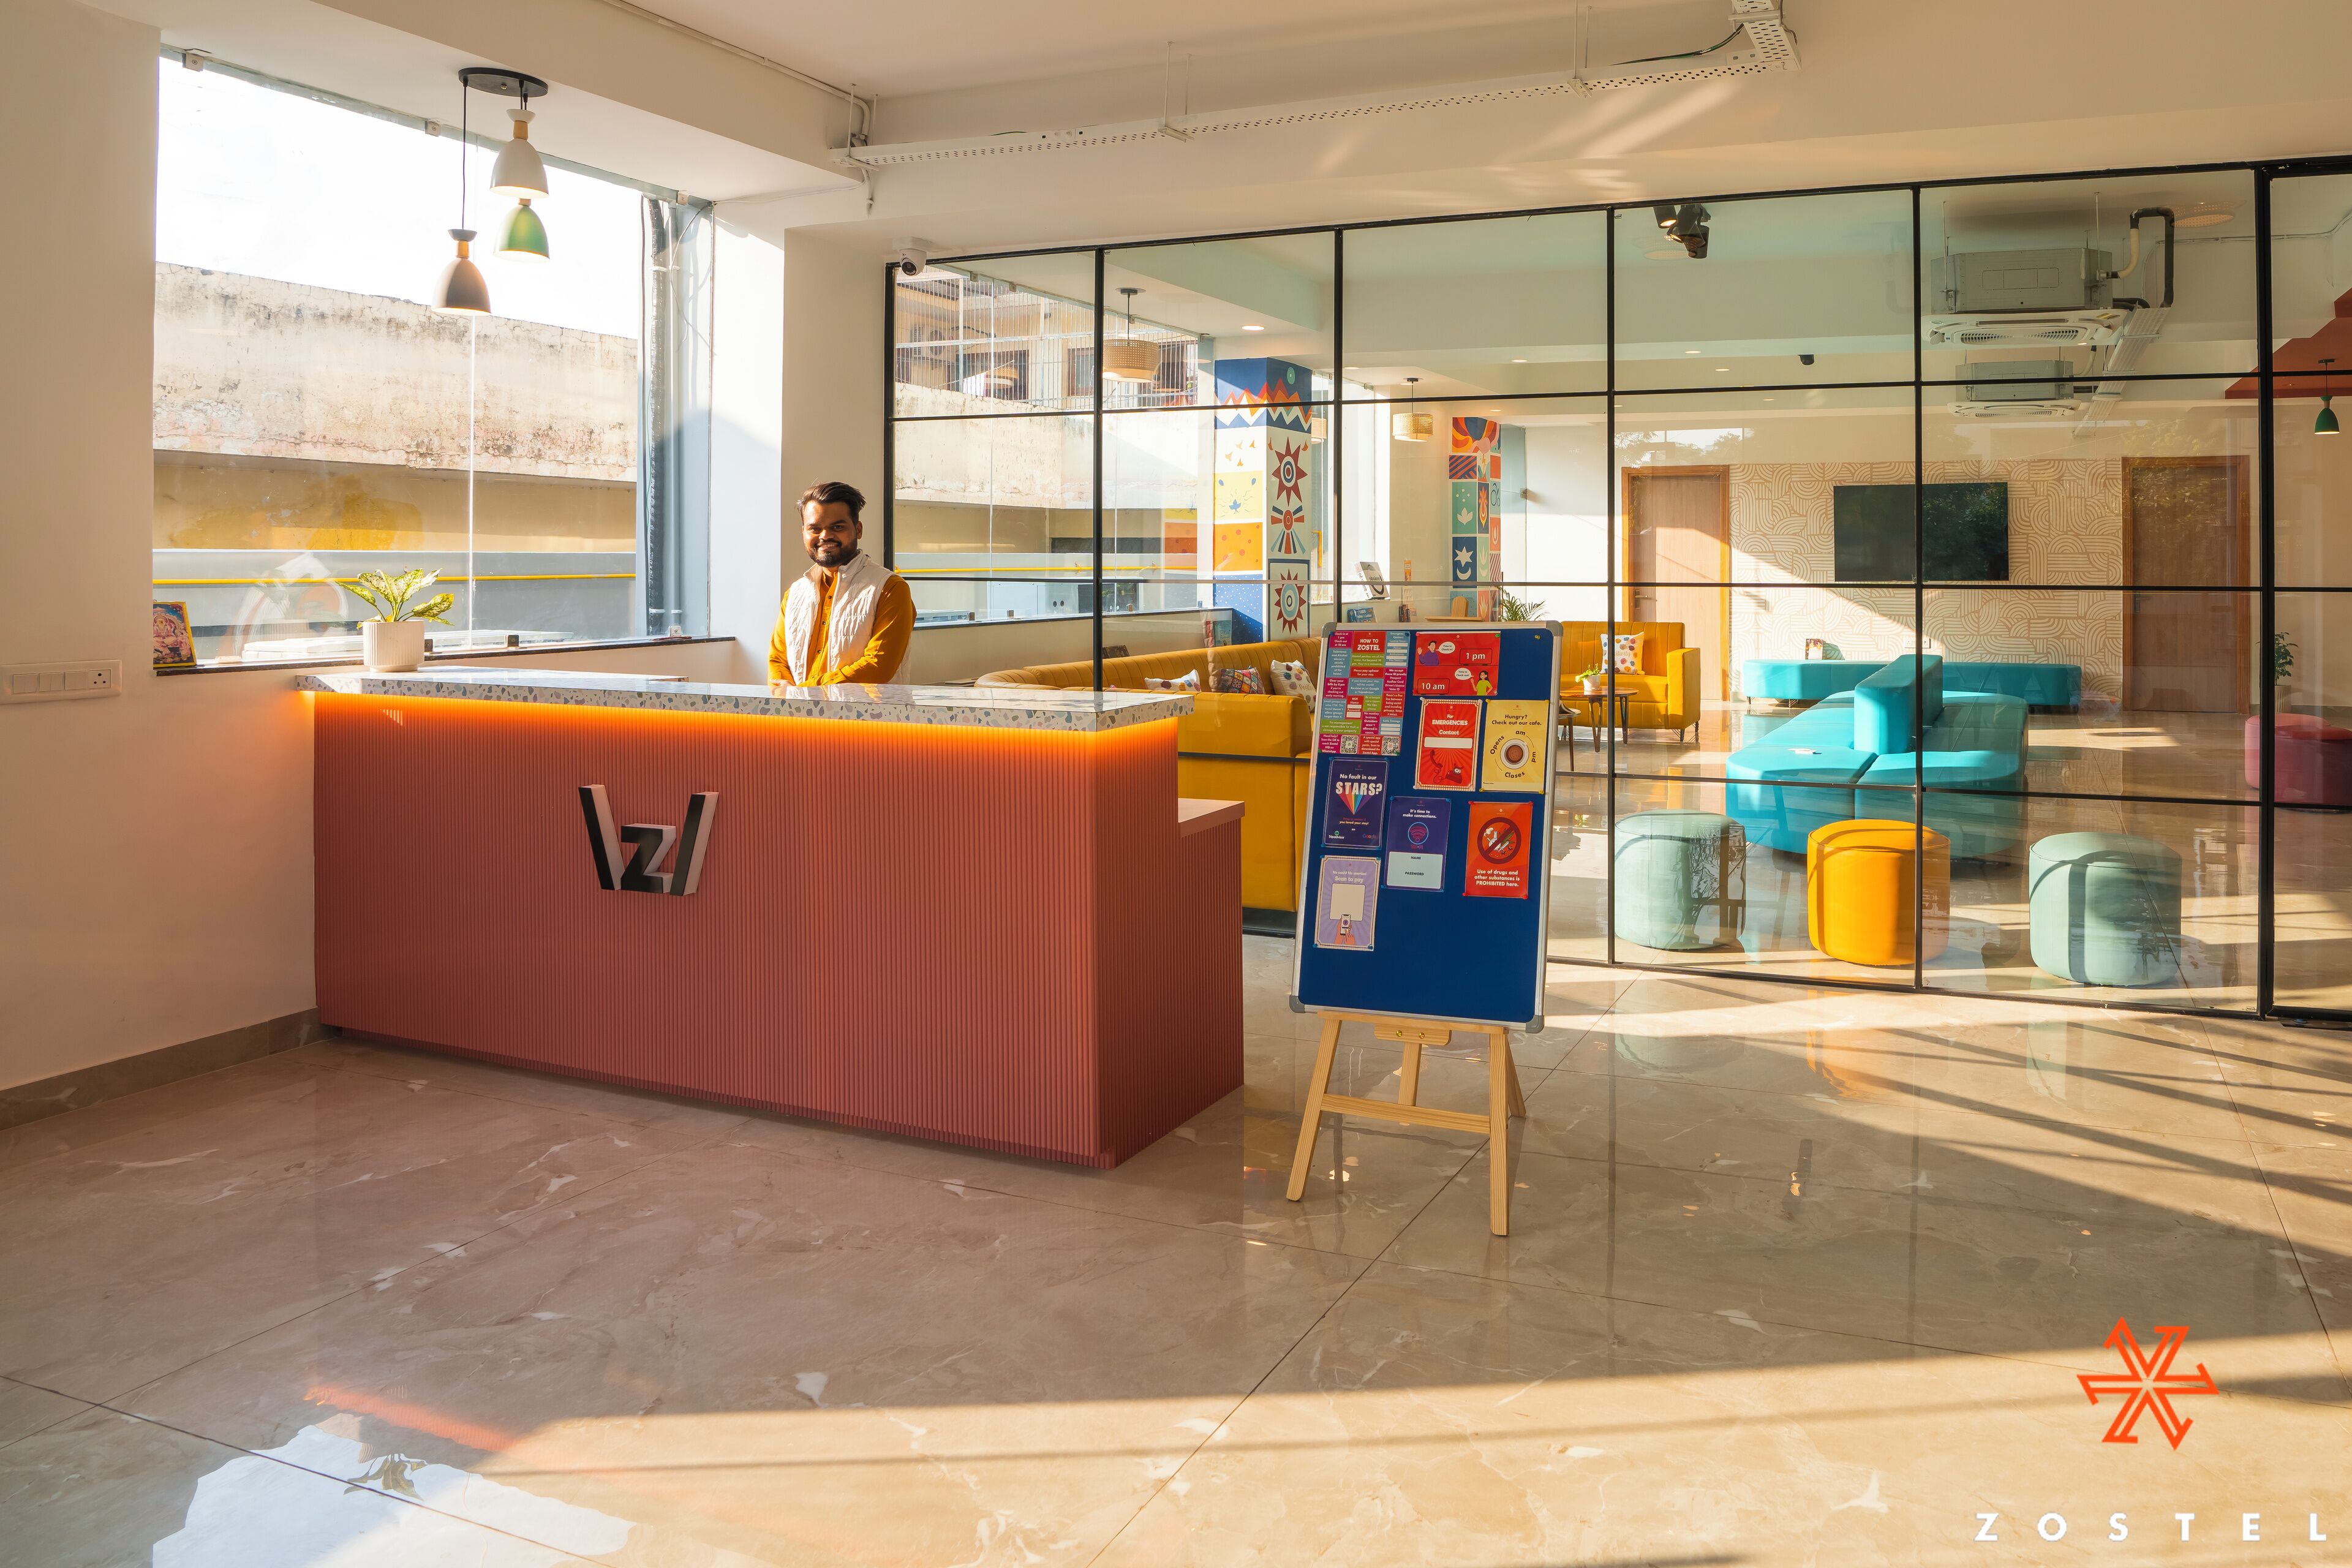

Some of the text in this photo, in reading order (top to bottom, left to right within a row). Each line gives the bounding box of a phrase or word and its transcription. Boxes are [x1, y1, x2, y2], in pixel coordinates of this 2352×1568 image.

[1490, 735, 1505, 755] Opens
[1531, 751, 1536, 763] pm
[1336, 782, 1382, 796] STARS?
